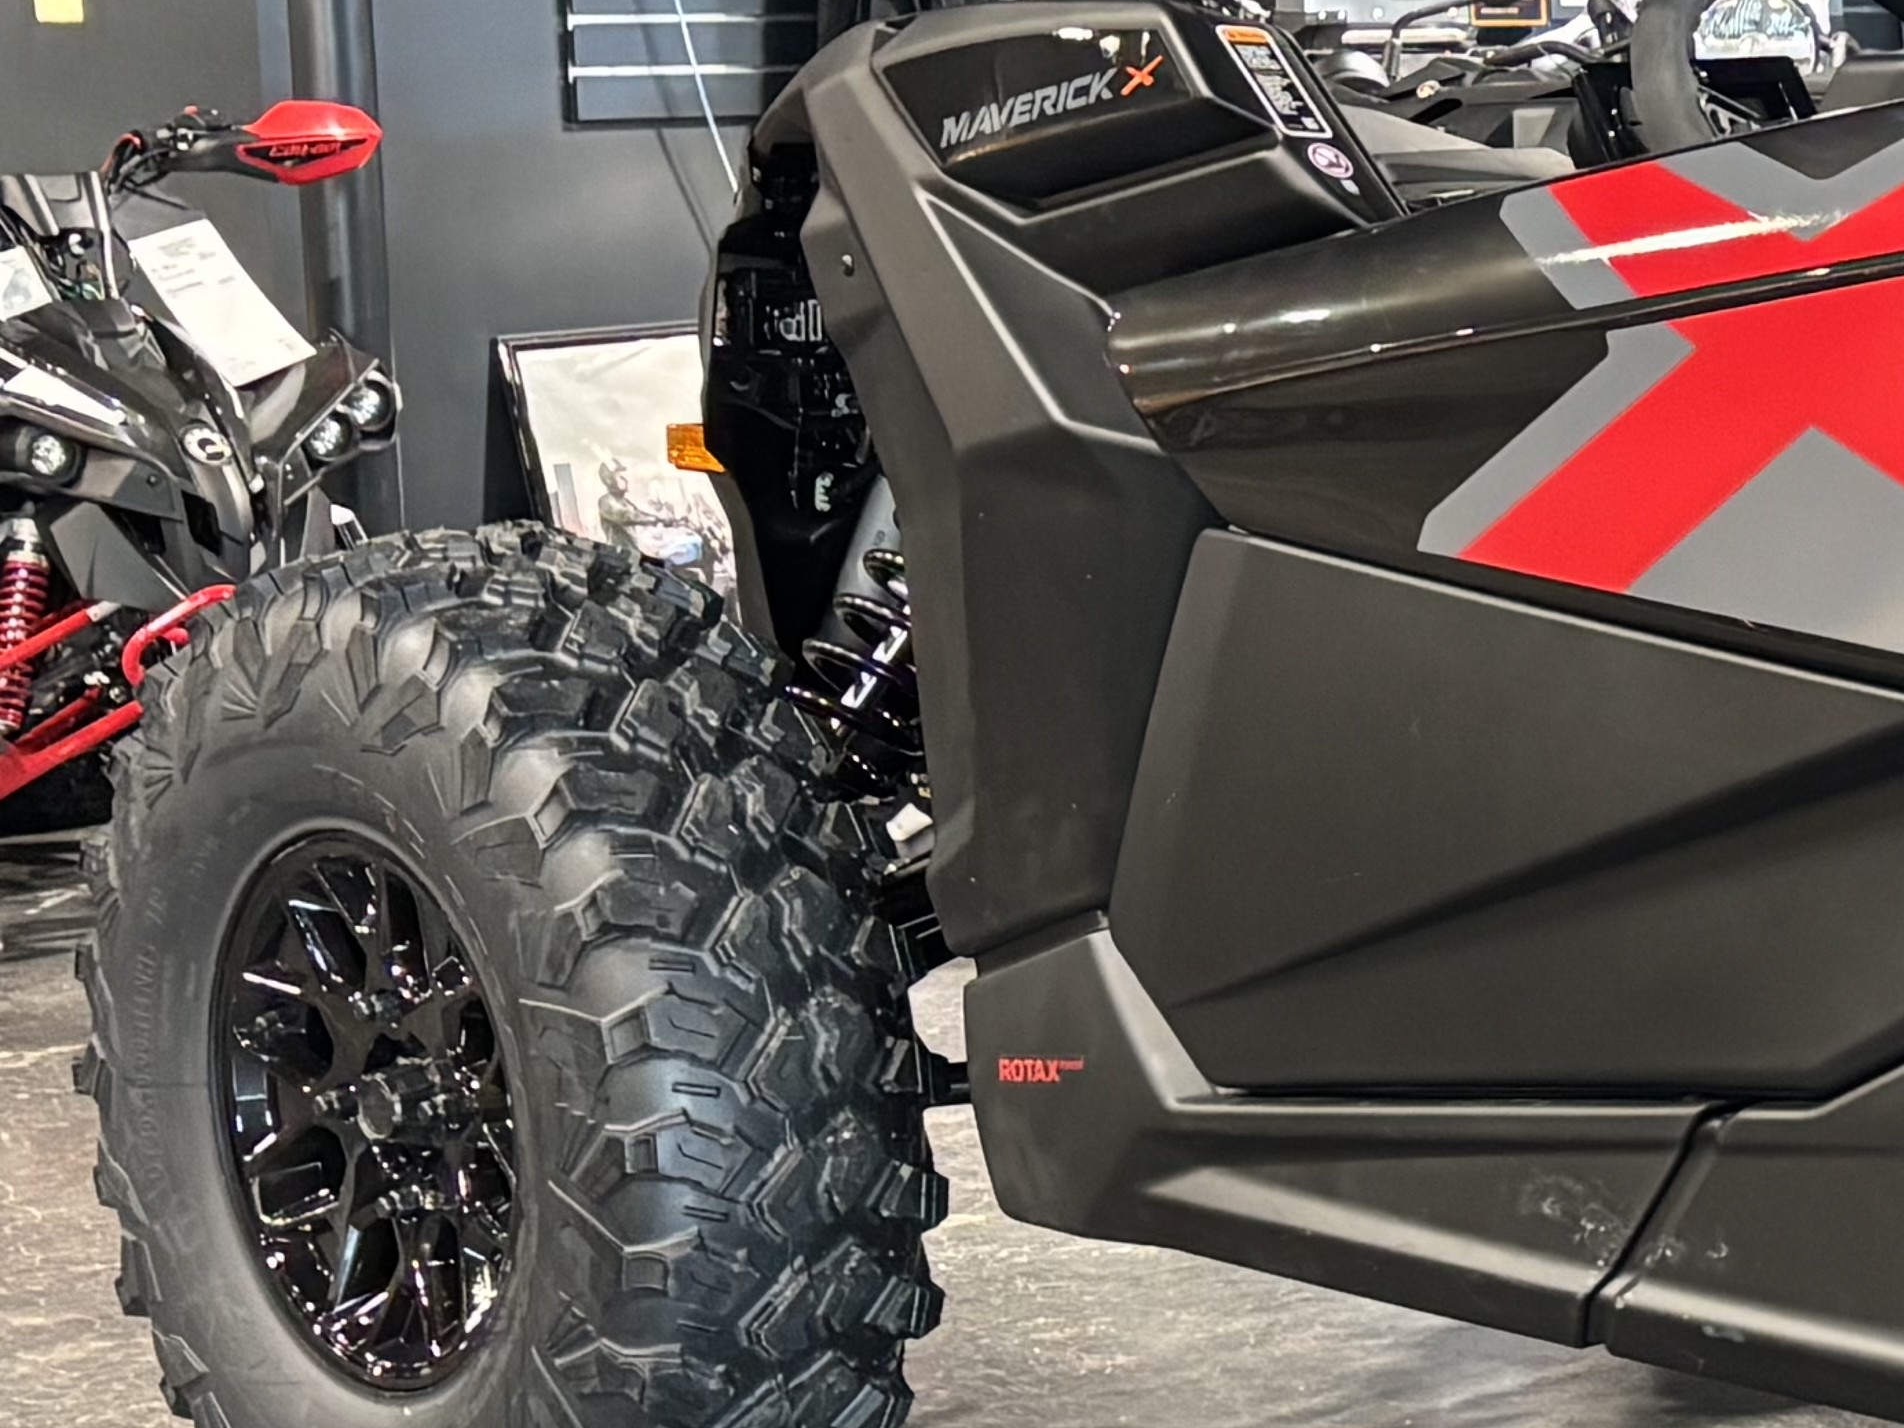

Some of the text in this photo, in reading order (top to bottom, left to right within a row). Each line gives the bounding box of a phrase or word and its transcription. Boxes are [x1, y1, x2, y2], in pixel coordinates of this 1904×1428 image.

[940, 68, 1119, 149] MAVERICK
[1119, 54, 1164, 98] X
[998, 1057, 1061, 1082] ROTAX
